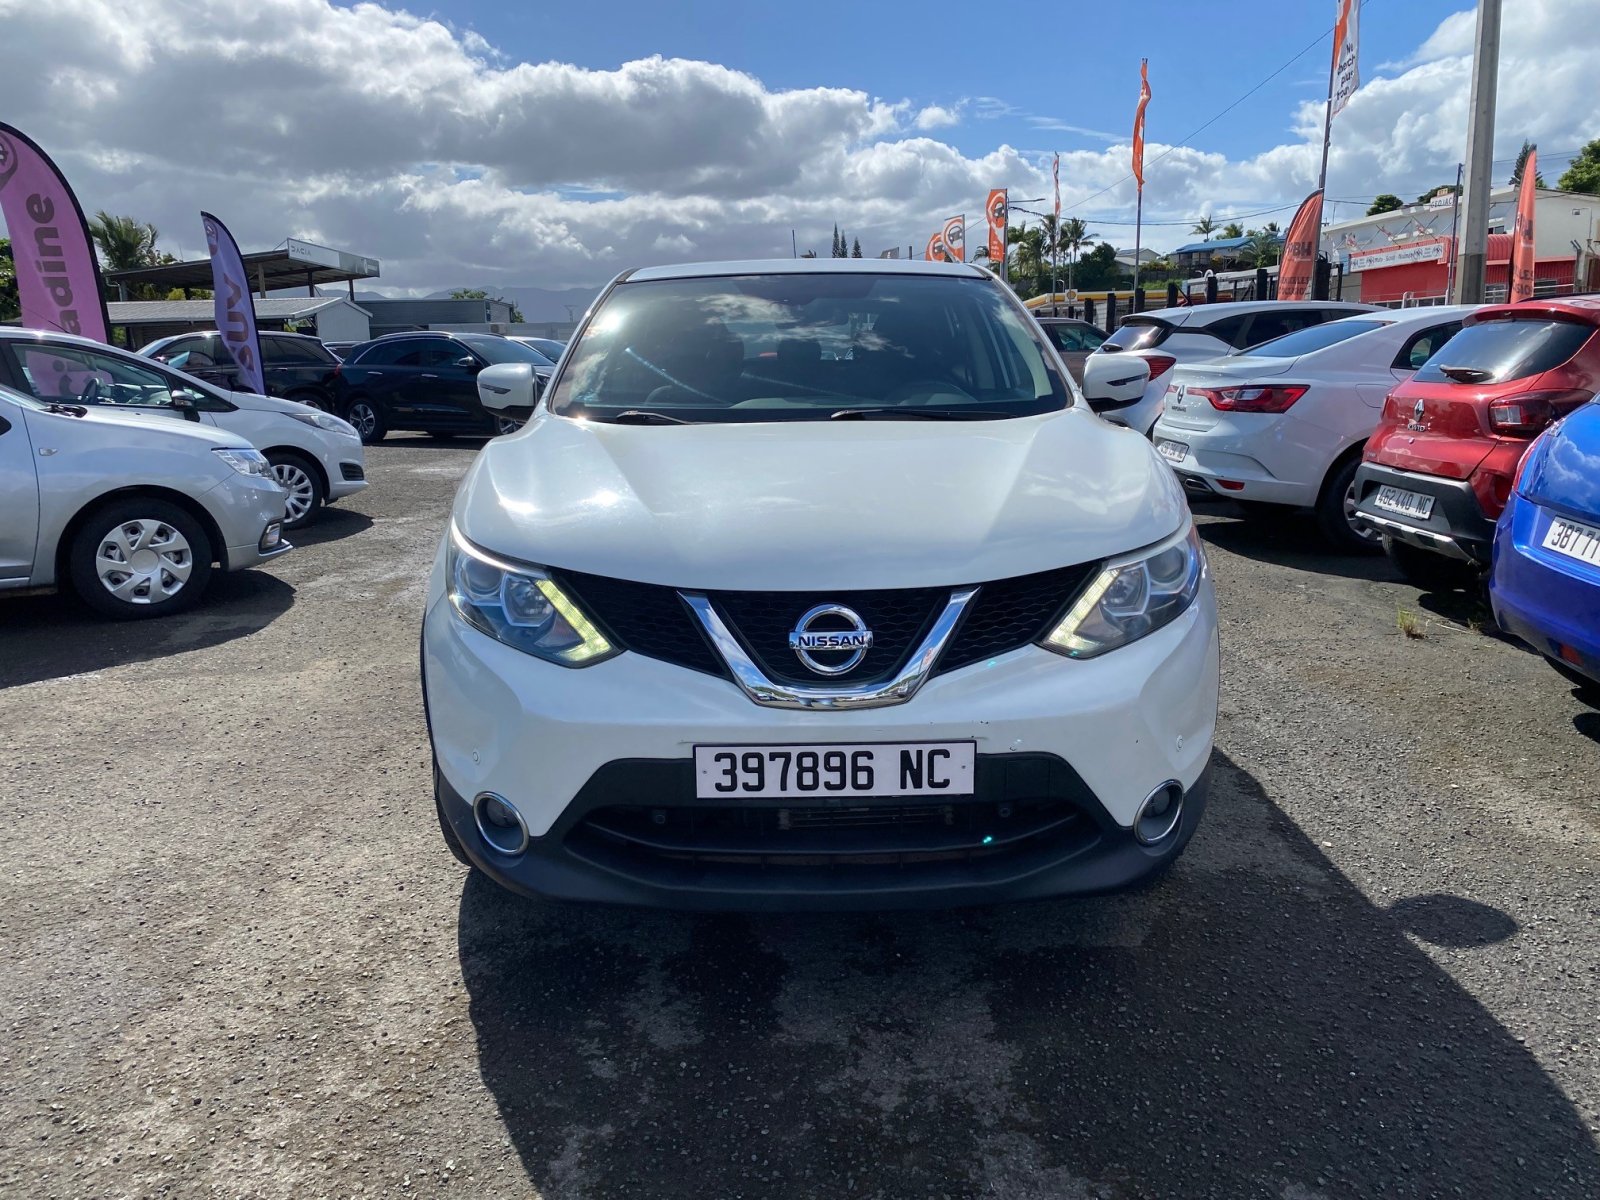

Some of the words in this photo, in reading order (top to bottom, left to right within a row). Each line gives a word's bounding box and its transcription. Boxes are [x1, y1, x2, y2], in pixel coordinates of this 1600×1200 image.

[290, 245, 312, 257] DACIA
[1415, 495, 1431, 515] NC
[1551, 521, 1584, 552] 387
[798, 634, 865, 648] NISSAN
[714, 750, 875, 792] 397896
[899, 748, 951, 790] NC
